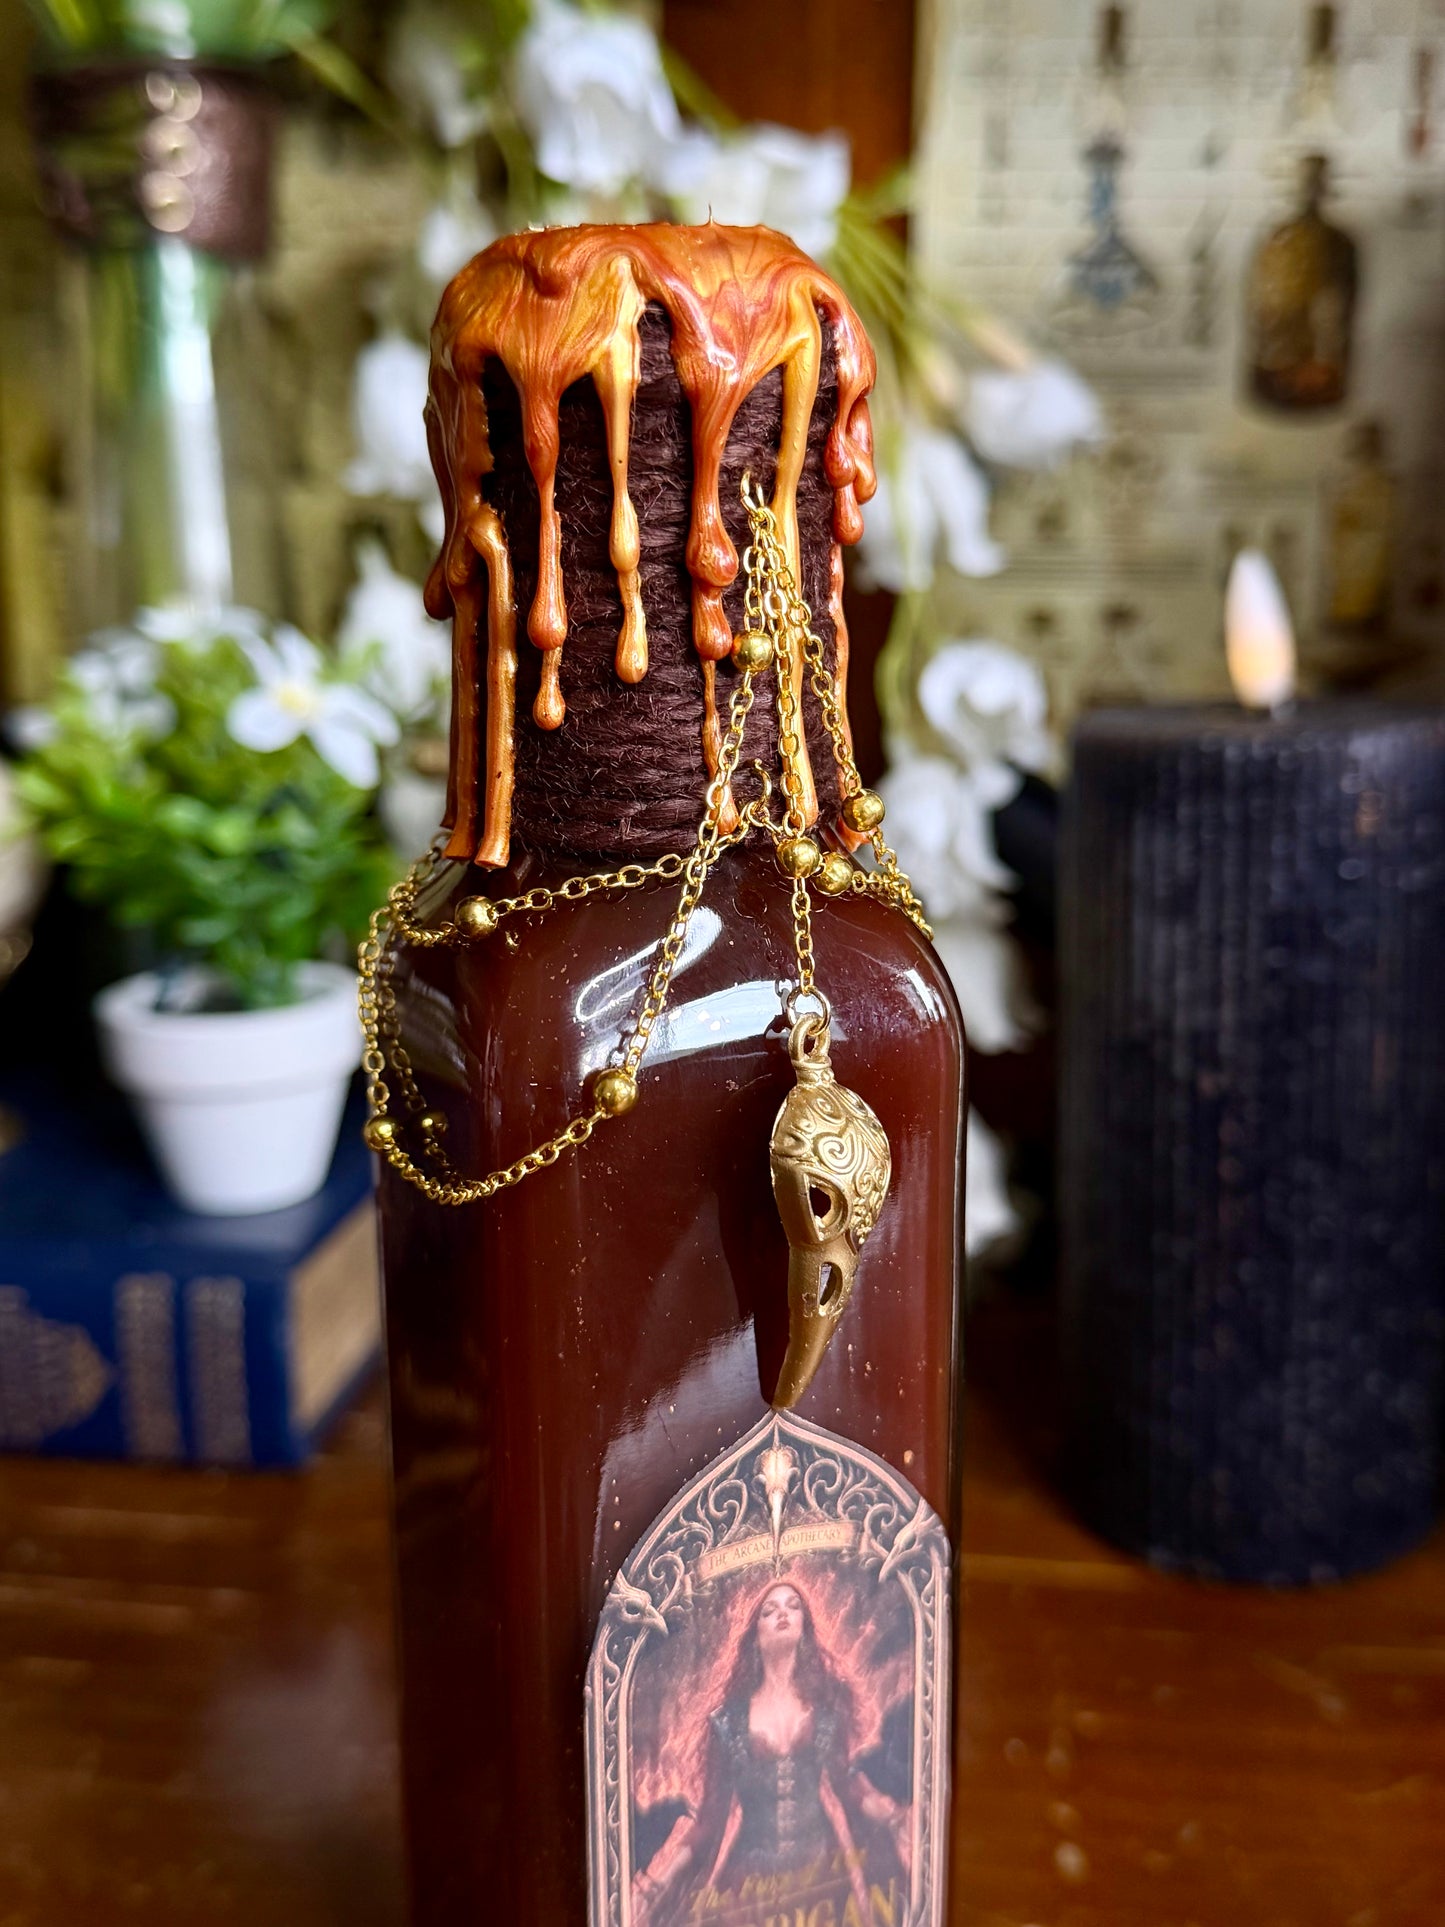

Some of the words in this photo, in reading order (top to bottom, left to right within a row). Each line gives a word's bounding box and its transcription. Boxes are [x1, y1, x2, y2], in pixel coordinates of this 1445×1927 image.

[708, 1552, 729, 1567] THE
[732, 1538, 774, 1560] ARCANE
[780, 1527, 842, 1546] APOTHECARY
